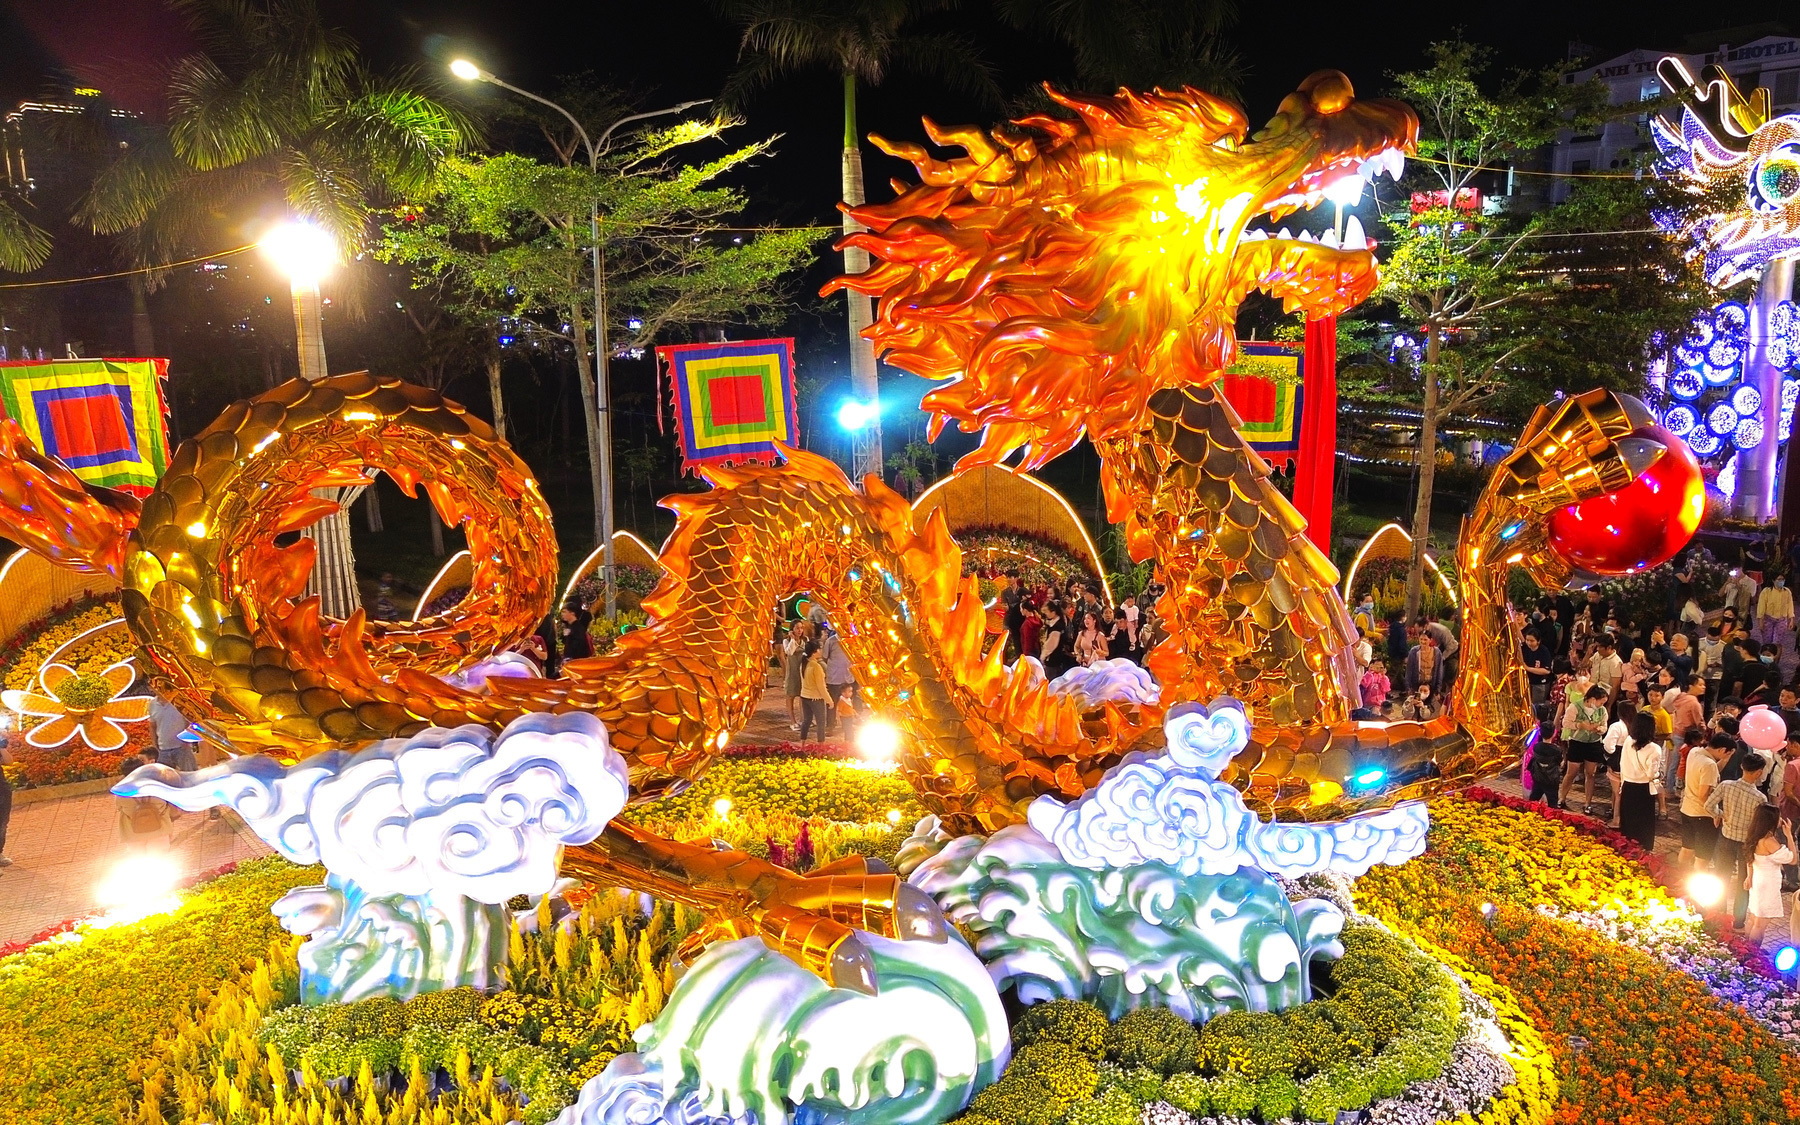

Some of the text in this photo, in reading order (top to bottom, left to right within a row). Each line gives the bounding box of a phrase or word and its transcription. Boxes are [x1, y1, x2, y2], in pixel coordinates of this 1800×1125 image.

[1737, 41, 1799, 60] HOTEL
[1594, 61, 1660, 79] ANH TU
